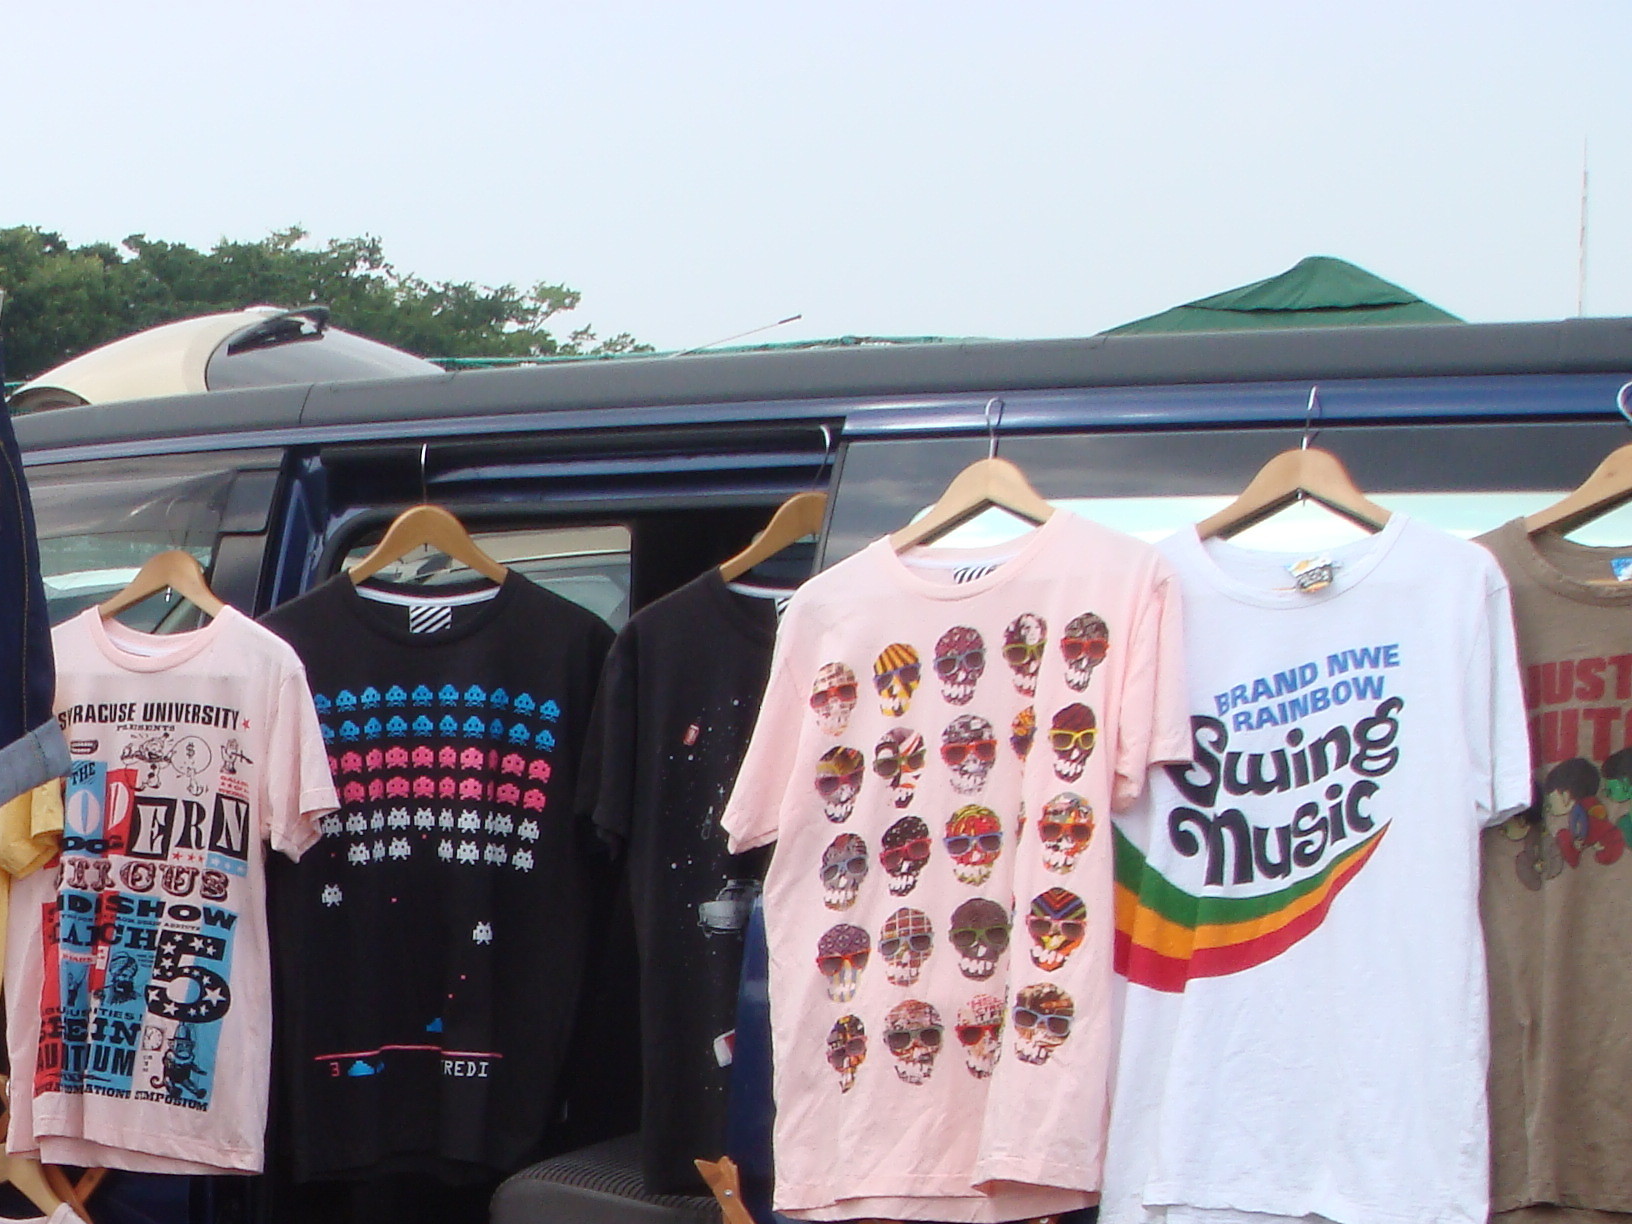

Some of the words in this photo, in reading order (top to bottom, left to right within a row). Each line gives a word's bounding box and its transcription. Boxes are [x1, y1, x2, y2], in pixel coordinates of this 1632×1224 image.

[1214, 662, 1319, 717] BRAND
[1326, 643, 1400, 677] NWE
[1232, 675, 1385, 733] RAINBOW
[58, 703, 136, 731] SYRACUSE
[142, 703, 240, 730] UNIVERSITY
[71, 761, 96, 786] THE
[1163, 696, 1404, 808] Swing
[68, 782, 249, 858] ODERN
[144, 929, 232, 1024] 5
[441, 1060, 489, 1077] REDI
